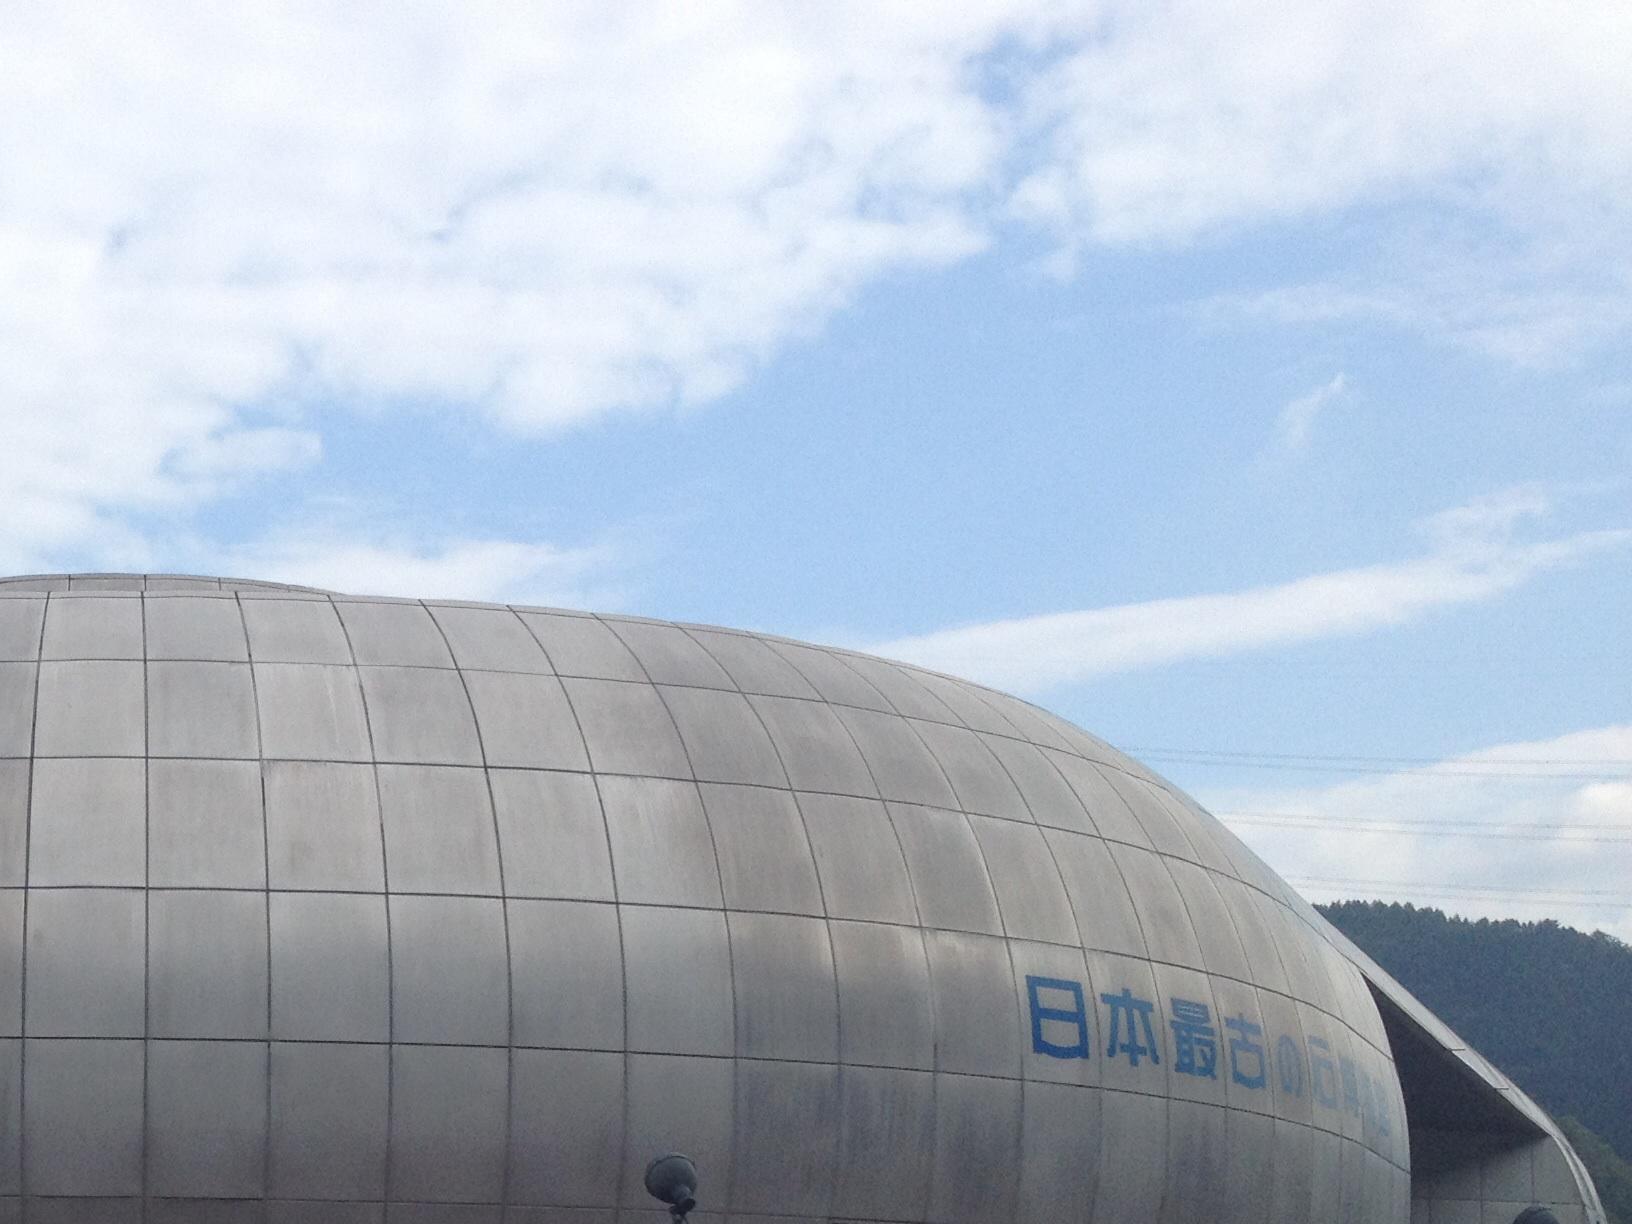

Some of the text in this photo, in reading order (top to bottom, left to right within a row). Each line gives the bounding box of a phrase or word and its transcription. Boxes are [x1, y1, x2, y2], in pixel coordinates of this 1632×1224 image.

[1025, 974, 1392, 1137] 日本最古の石
